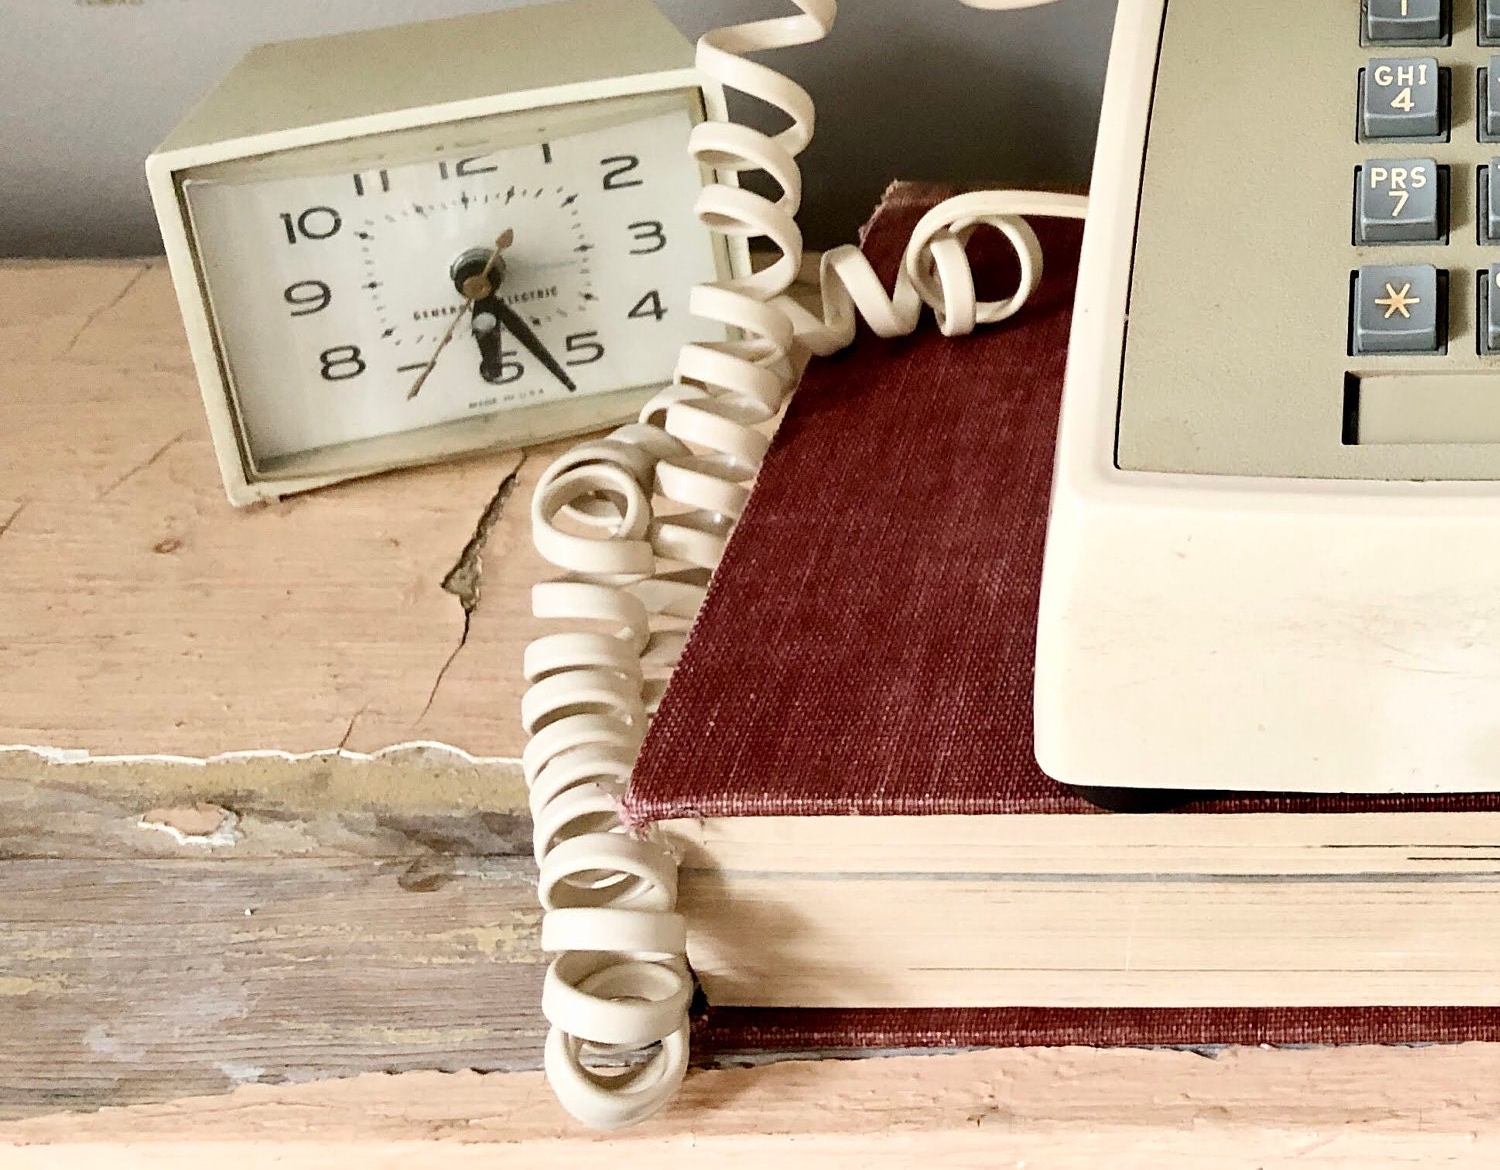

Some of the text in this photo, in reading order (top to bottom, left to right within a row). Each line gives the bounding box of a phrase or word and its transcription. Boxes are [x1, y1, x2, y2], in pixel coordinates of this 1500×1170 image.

[1374, 65, 1427, 87] GHI
[1390, 88, 1415, 112] 4
[600, 154, 644, 191] 2
[1371, 167, 1427, 189] PRS
[1389, 191, 1409, 216] 7
[279, 205, 342, 245] 10
[627, 220, 667, 255] 3
[284, 279, 332, 316] 9
[413, 303, 470, 321] GENER
[627, 289, 668, 321] 4
[320, 344, 366, 381] 8
[565, 330, 605, 366] 5
